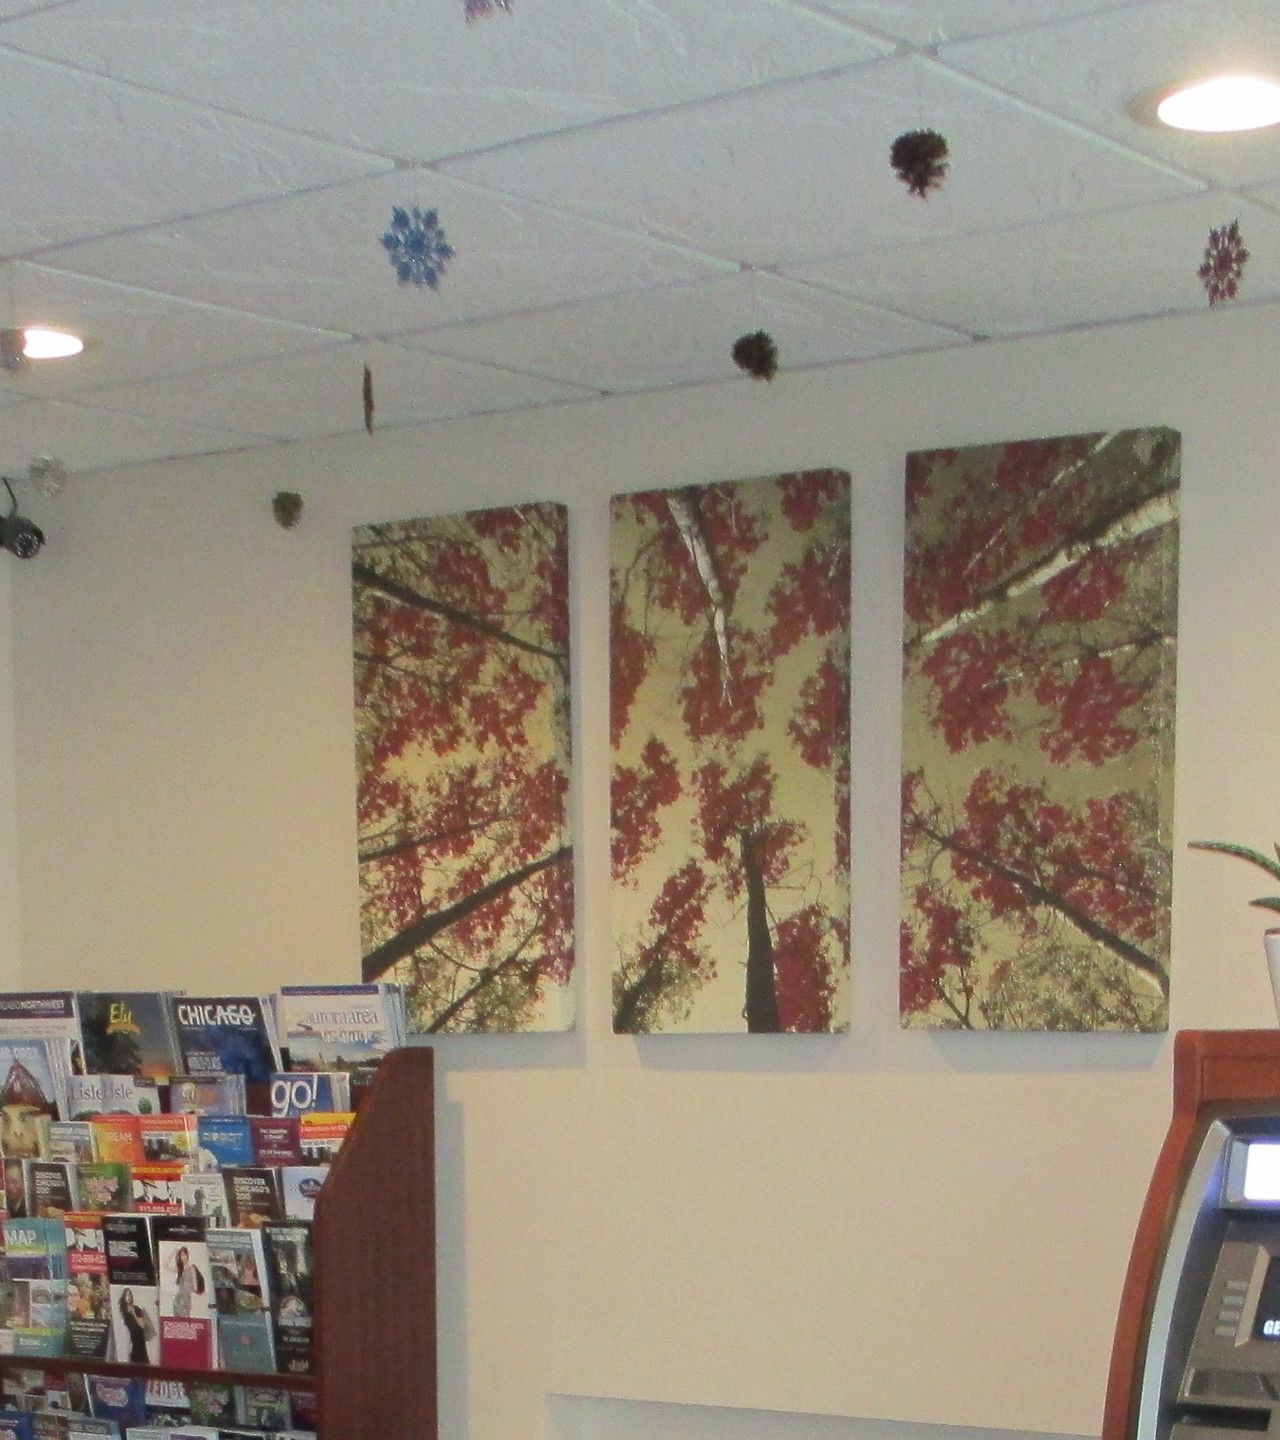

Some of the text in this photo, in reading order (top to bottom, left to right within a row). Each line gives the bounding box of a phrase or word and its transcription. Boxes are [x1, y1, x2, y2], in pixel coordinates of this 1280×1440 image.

[177, 1004, 258, 1026] CHICAGO
[270, 1075, 319, 1118] go!
[4, 1230, 37, 1246] MAP
